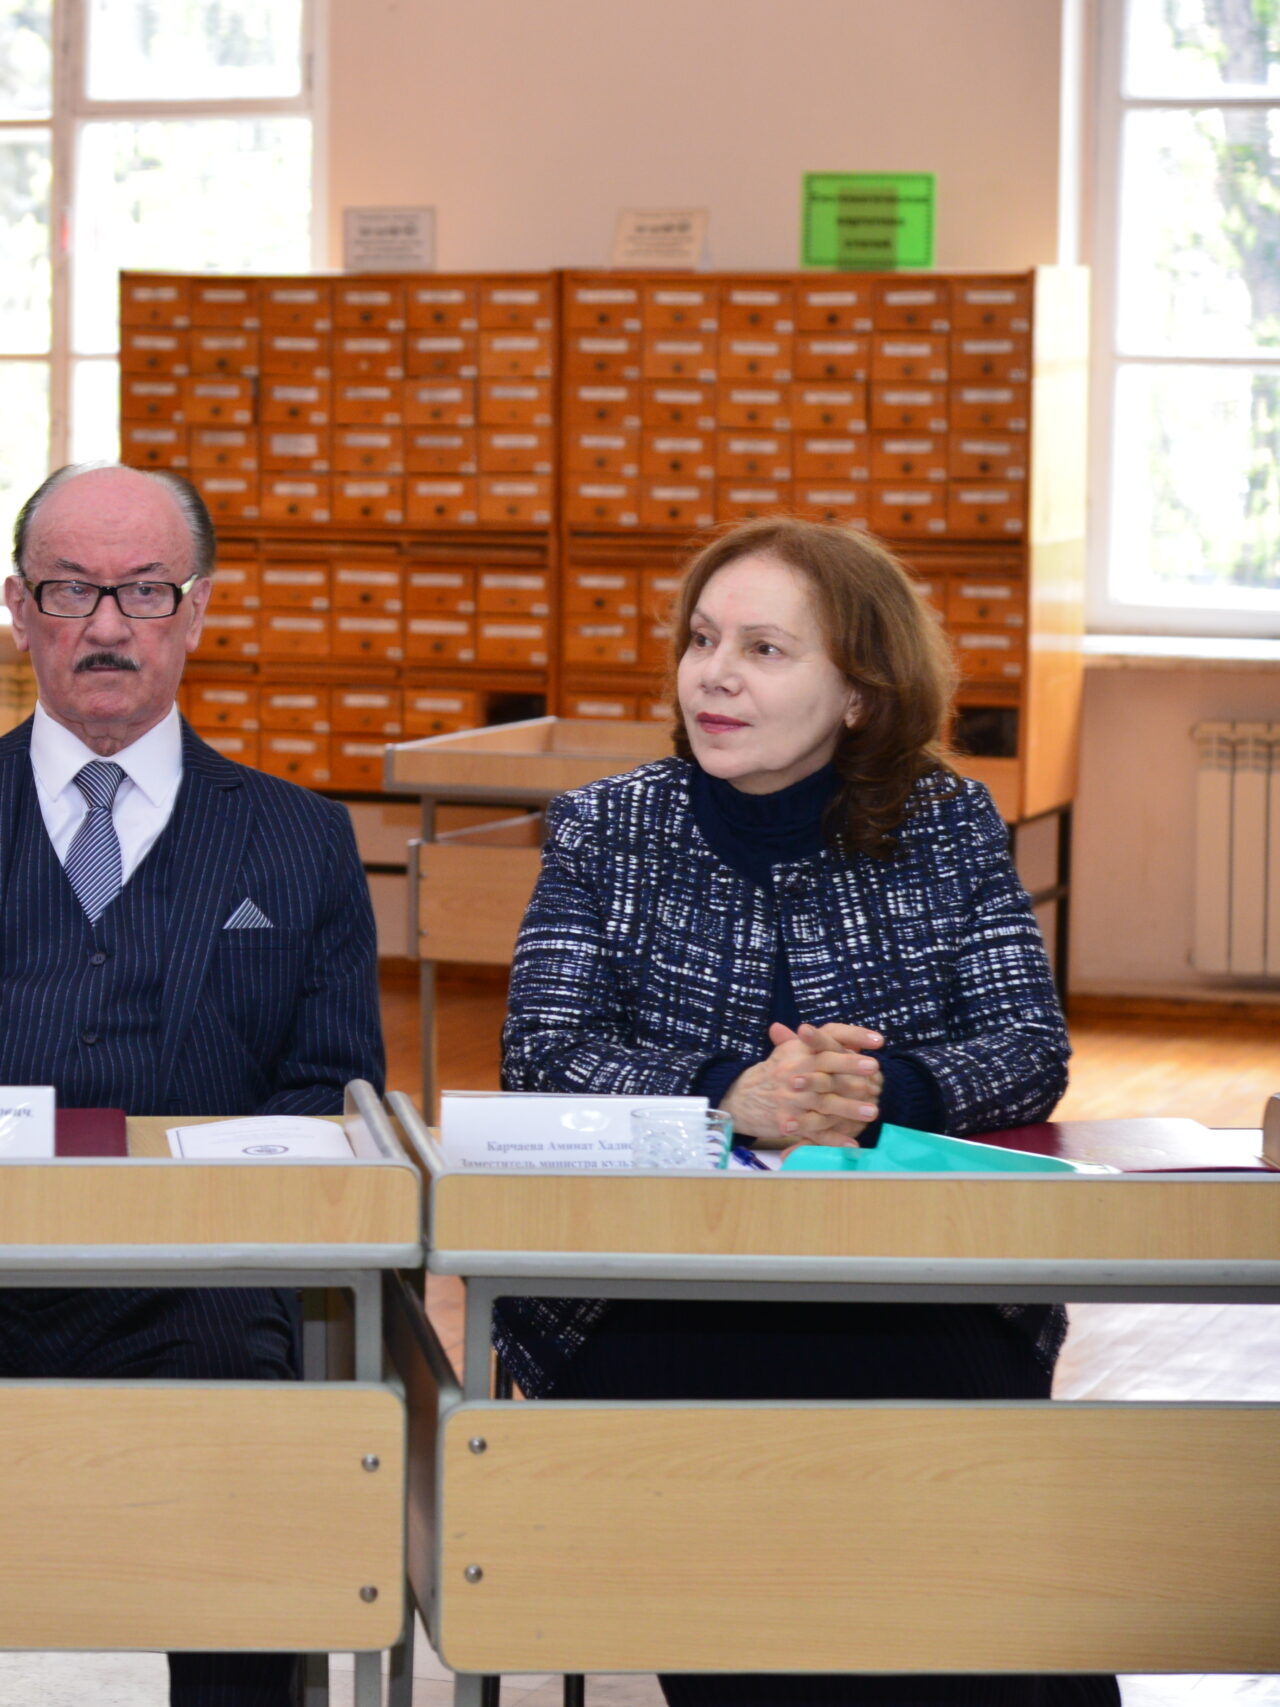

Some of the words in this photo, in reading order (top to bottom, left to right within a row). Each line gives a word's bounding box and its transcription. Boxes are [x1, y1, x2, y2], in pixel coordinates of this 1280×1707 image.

[487, 1140, 544, 1154] Карчаева
[547, 1141, 593, 1151] Аминат
[460, 1158, 537, 1168] Заместитель
[539, 1159, 598, 1169] министра
